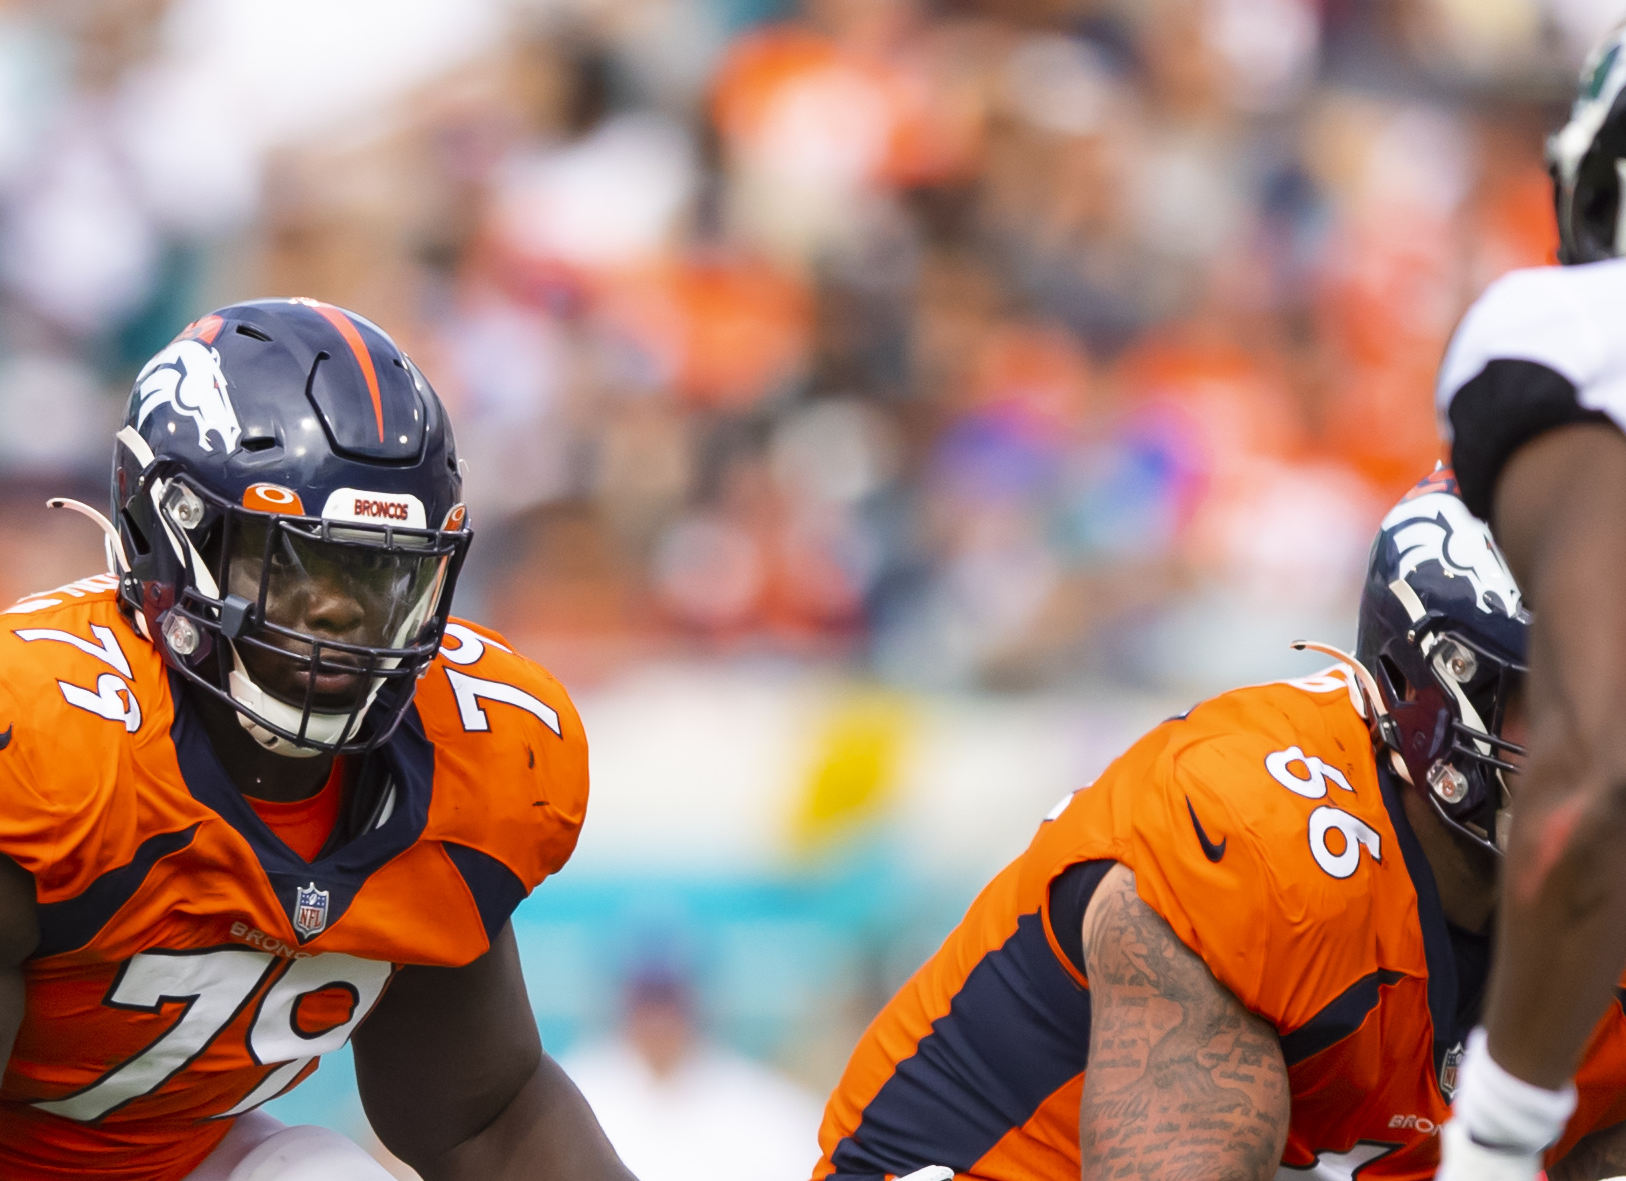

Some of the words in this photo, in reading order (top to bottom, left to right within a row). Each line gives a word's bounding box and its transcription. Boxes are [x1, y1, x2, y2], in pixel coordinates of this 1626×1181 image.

[354, 498, 409, 521] BRONCOS
[10, 619, 142, 734] 79
[438, 622, 564, 741] 79
[1264, 744, 1383, 880] 66
[299, 907, 322, 930] NFL
[29, 943, 397, 1127] 79
